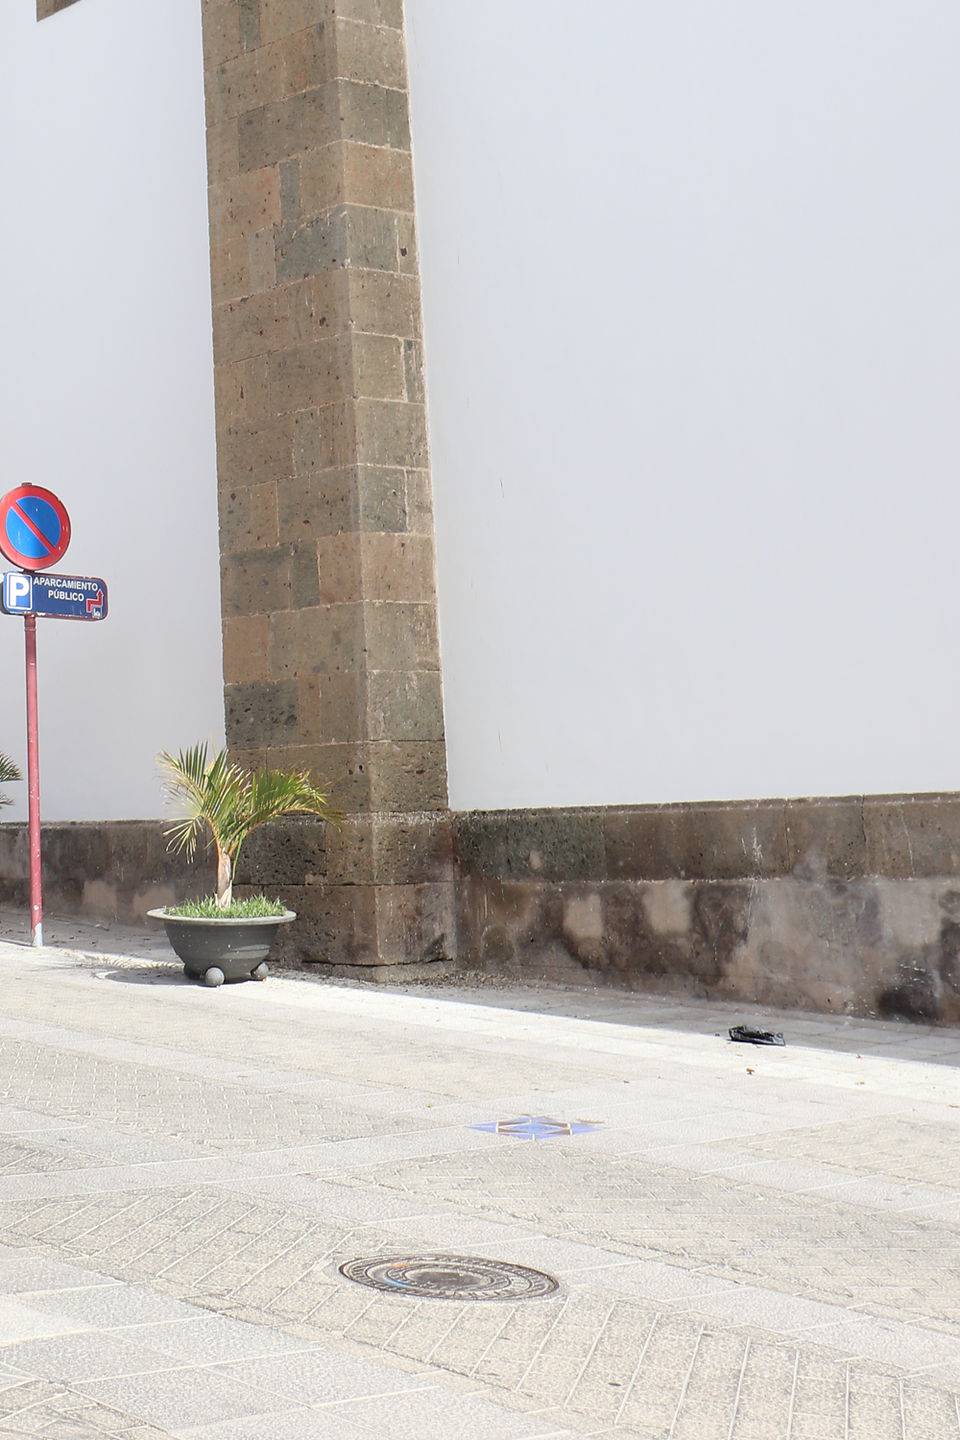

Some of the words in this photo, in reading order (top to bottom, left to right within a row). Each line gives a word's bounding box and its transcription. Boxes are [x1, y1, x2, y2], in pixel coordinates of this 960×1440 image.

[34, 577, 98, 591] APARCAMIENTO
[9, 576, 30, 607] P
[48, 589, 85, 602] PÚBLICO
